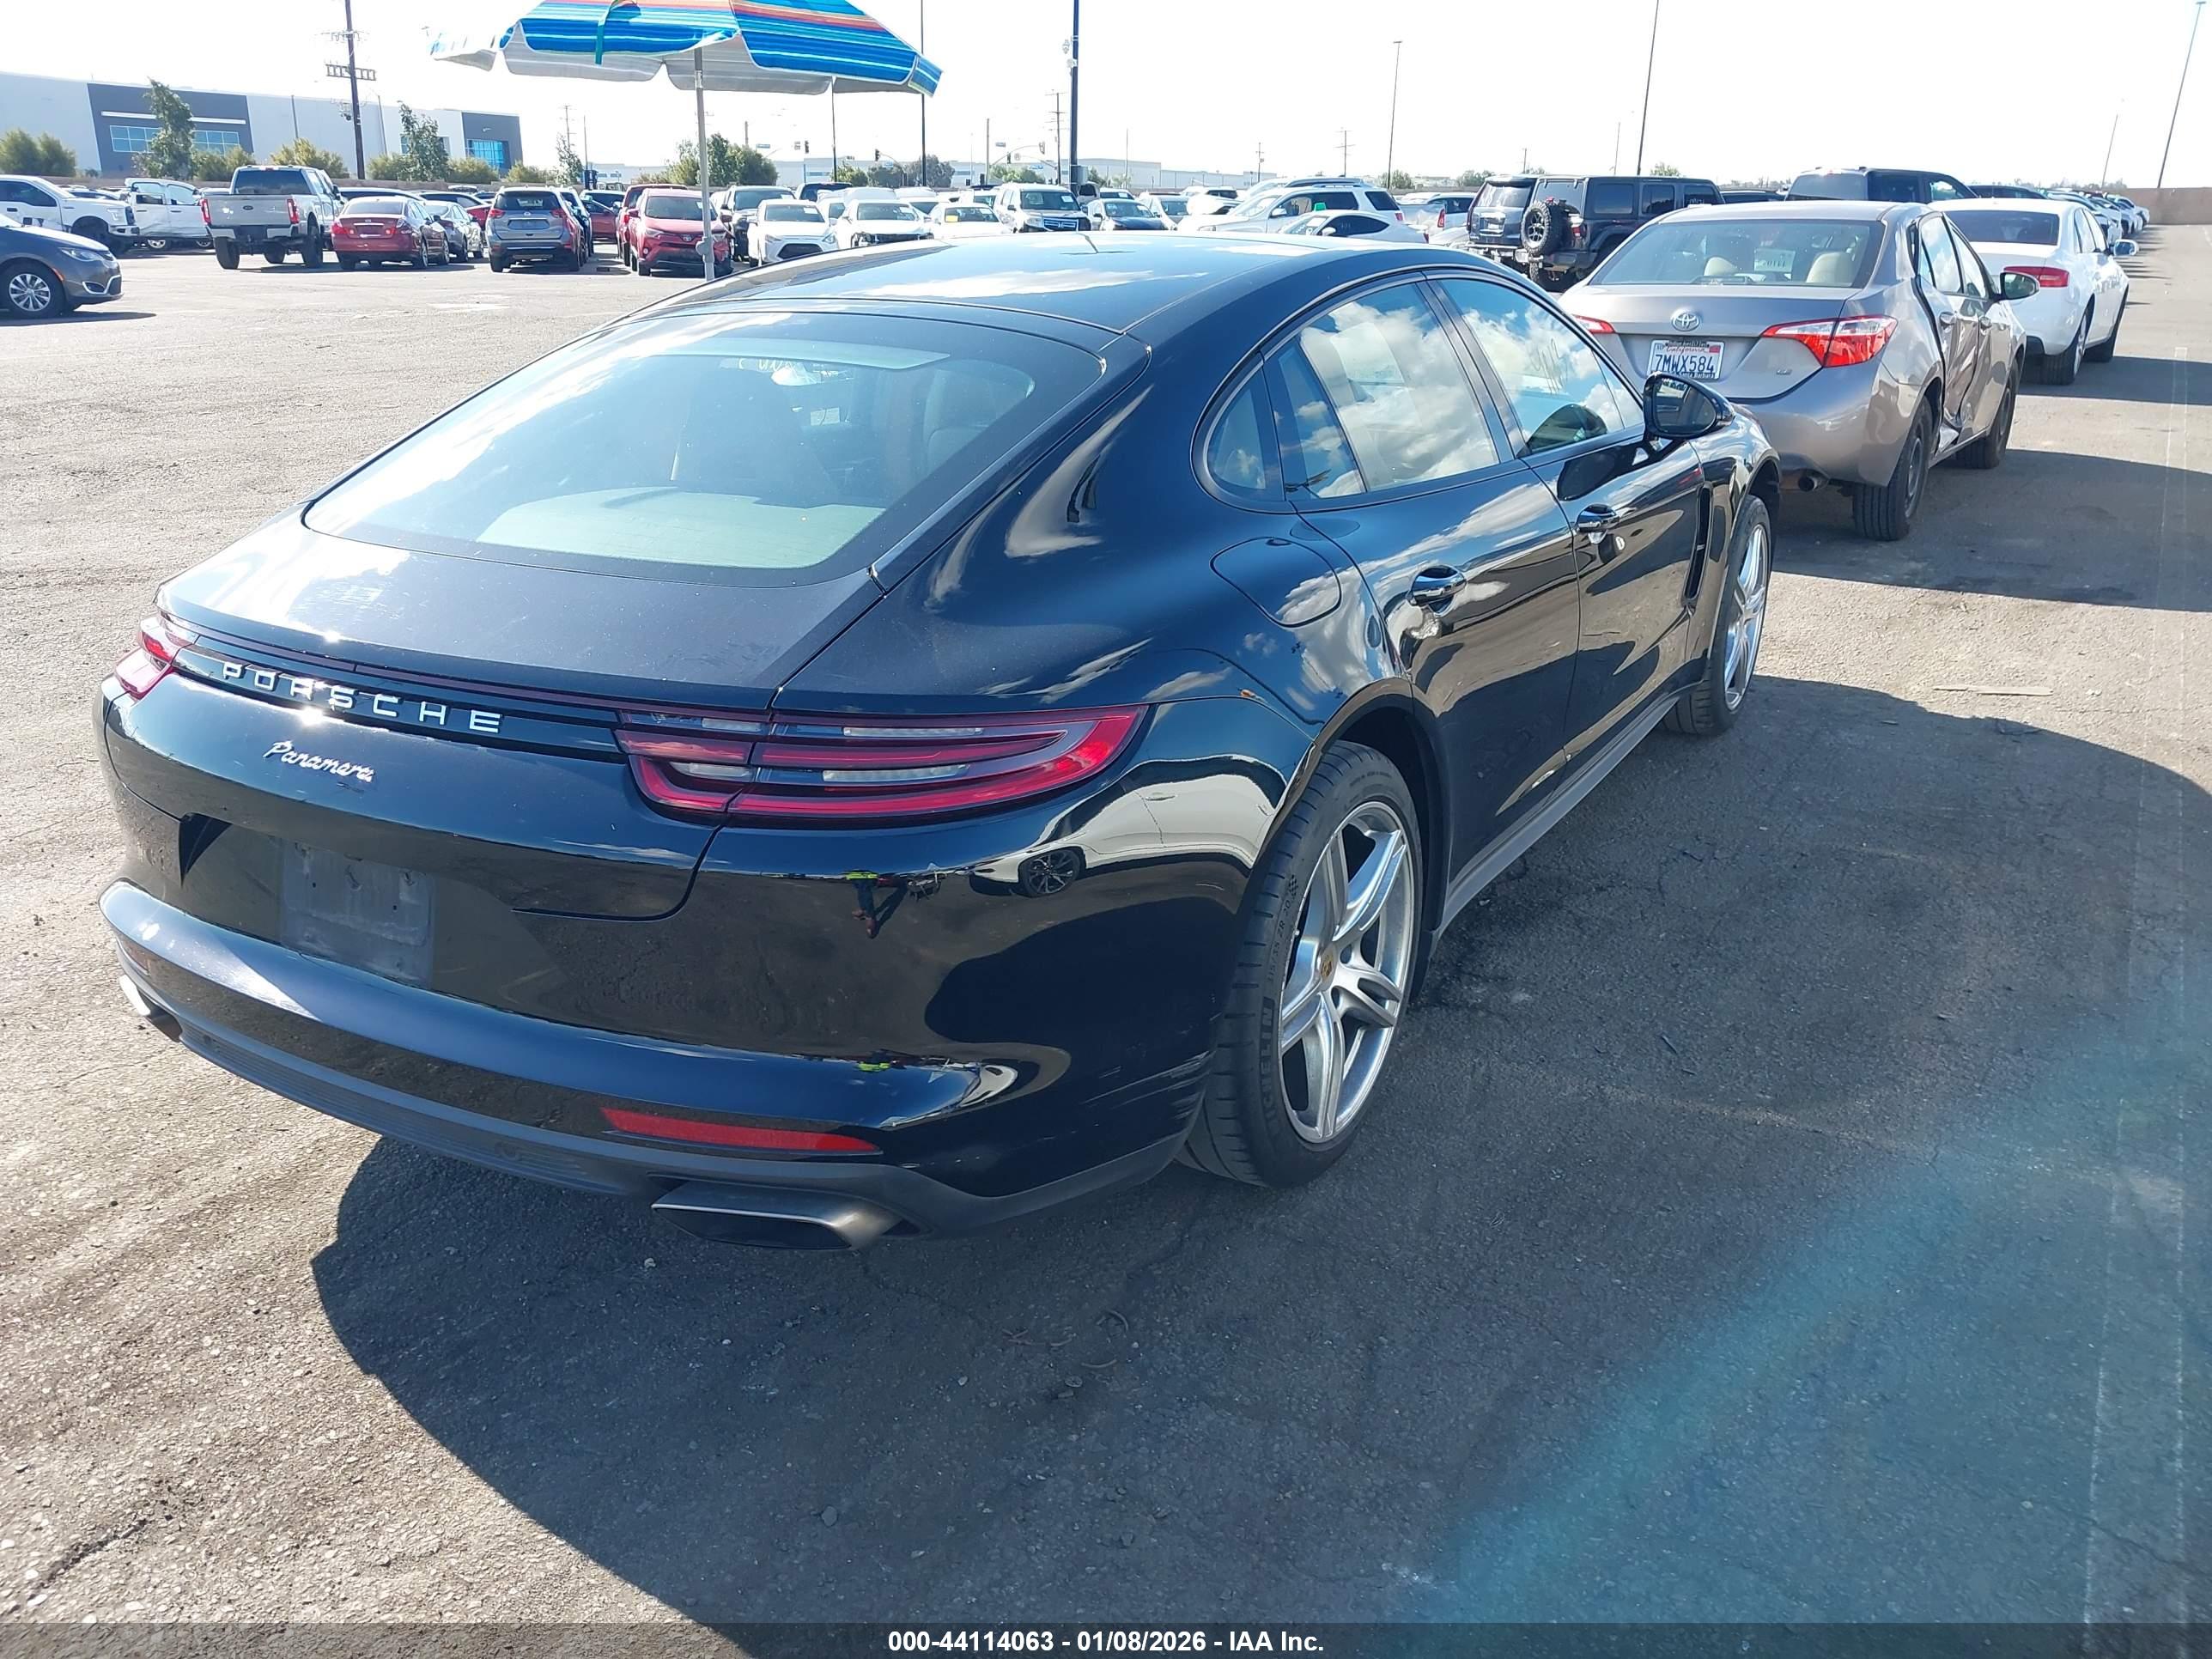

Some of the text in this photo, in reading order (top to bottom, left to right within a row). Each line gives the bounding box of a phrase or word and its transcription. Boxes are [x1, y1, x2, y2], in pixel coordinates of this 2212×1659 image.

[1655, 354, 1714, 374] 7MWX584
[1666, 344, 1705, 354] California
[222, 661, 501, 733] PORSCHE
[262, 740, 374, 782] Panamera
